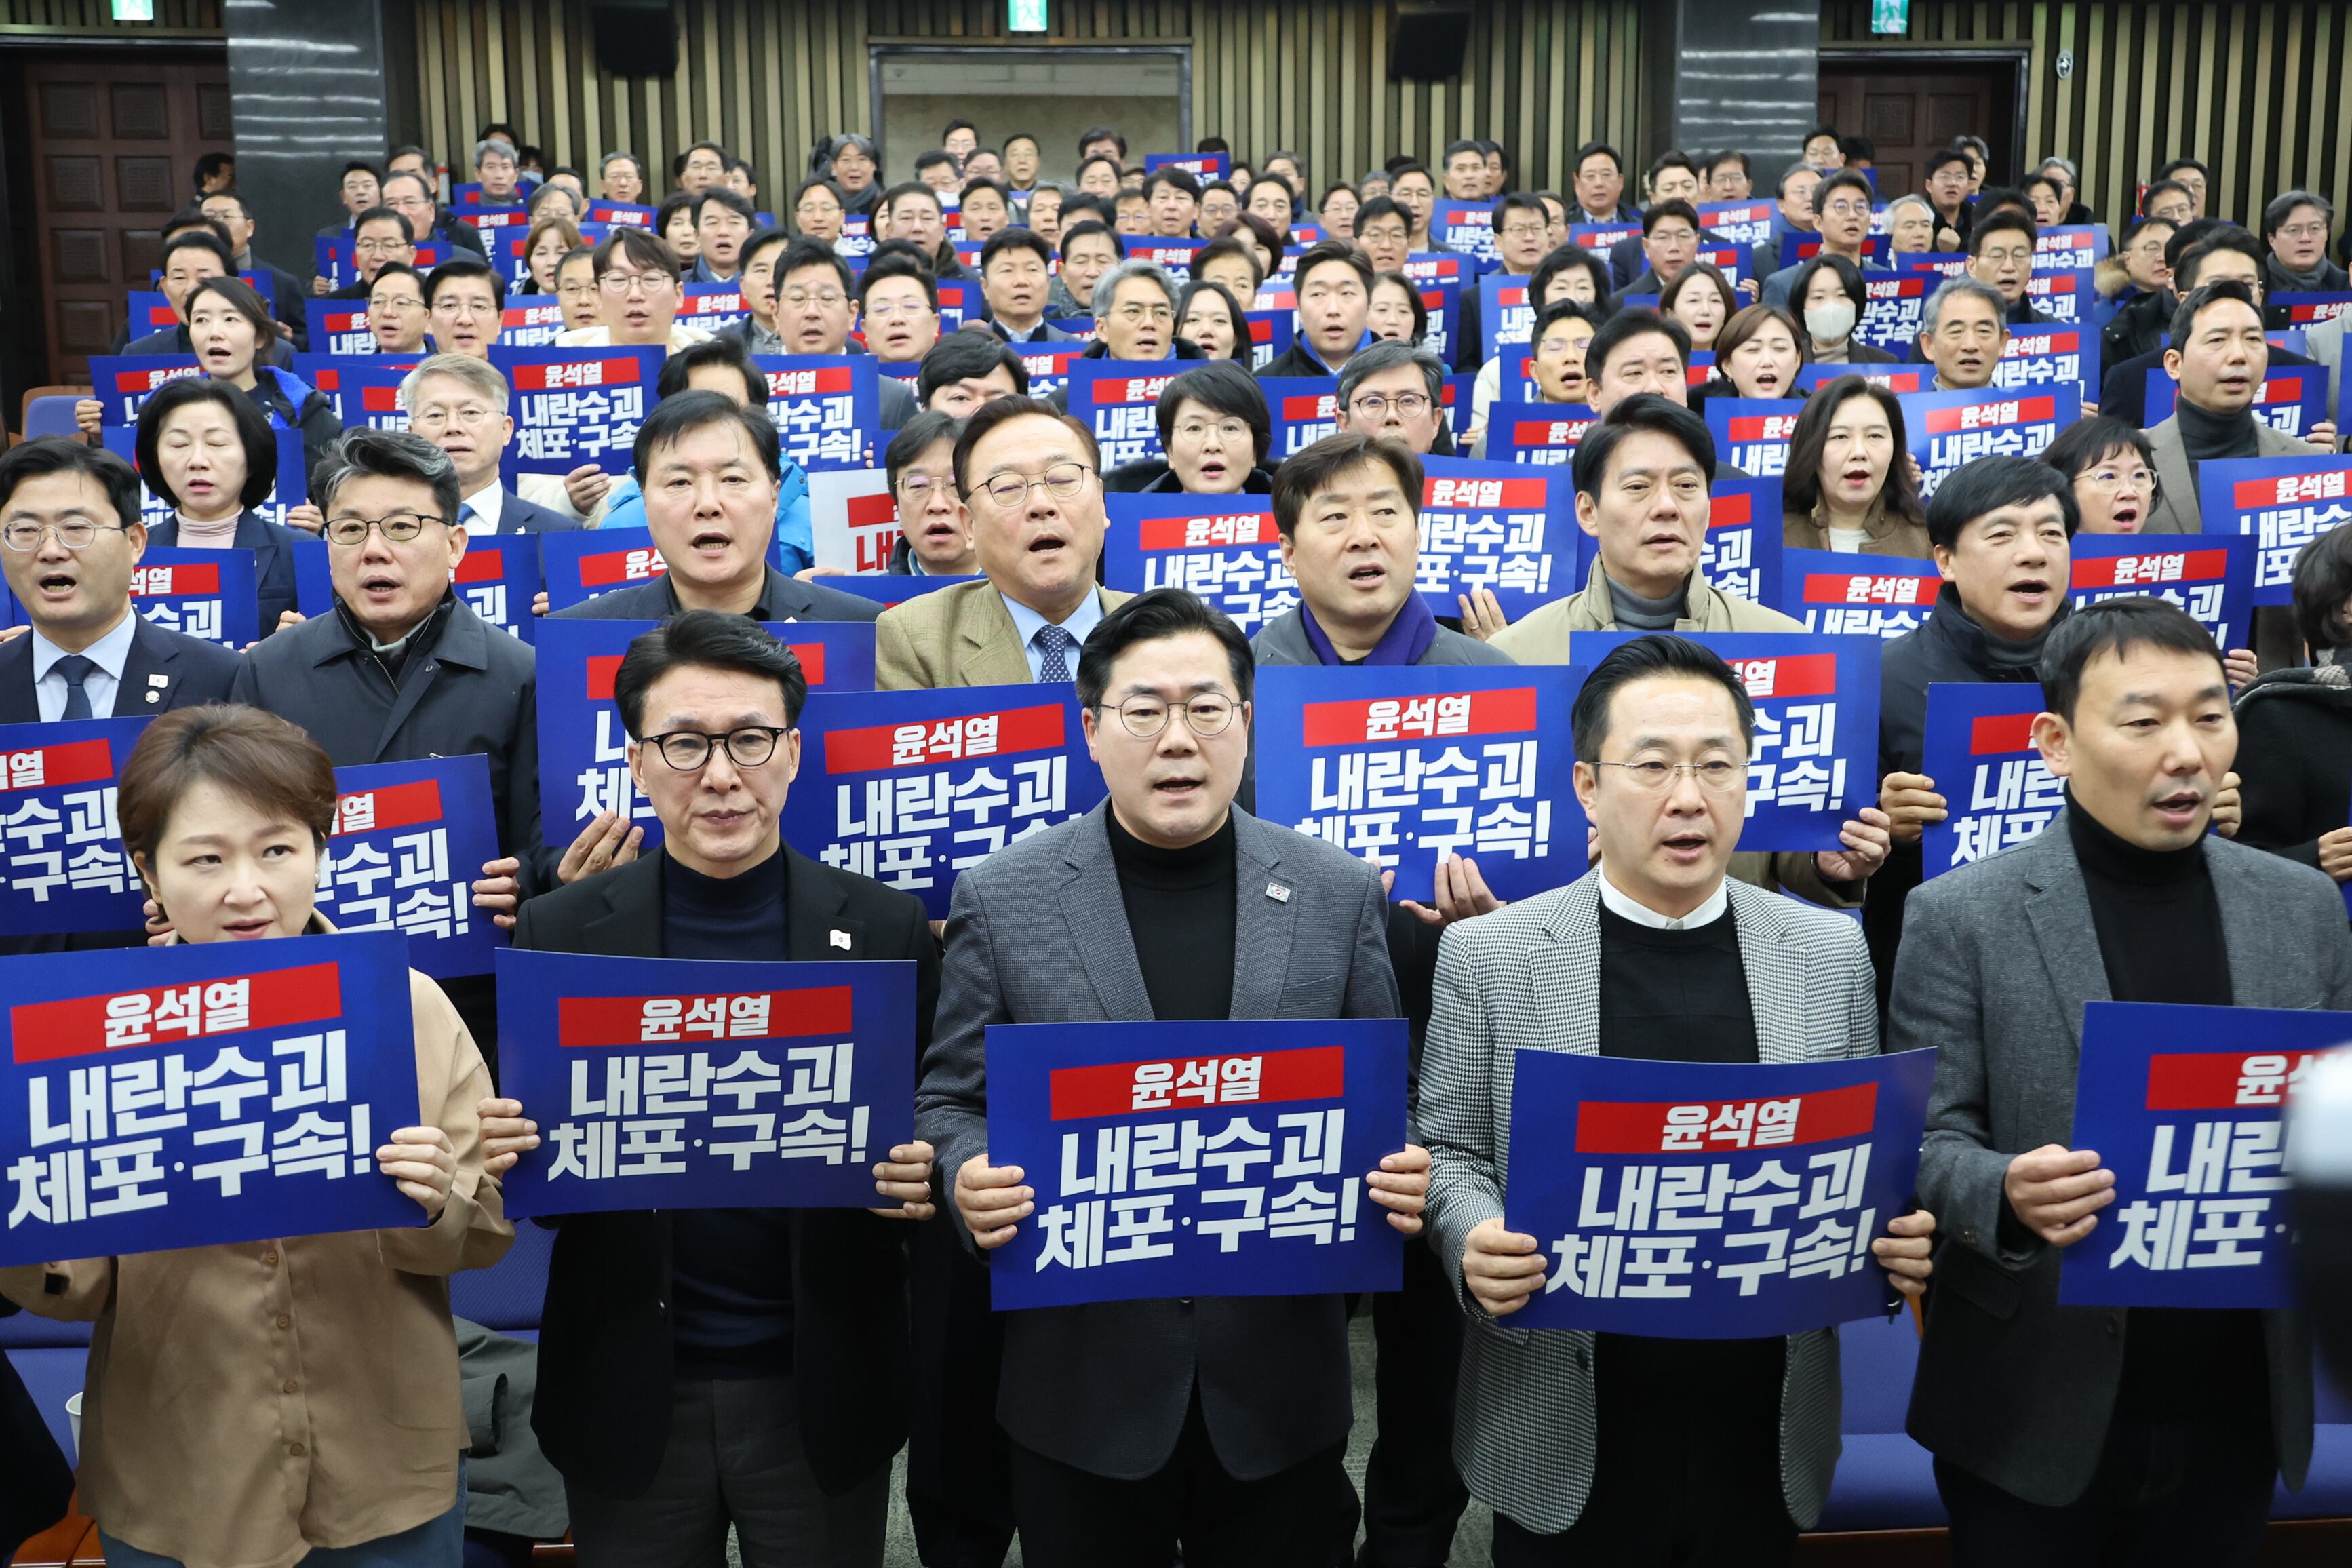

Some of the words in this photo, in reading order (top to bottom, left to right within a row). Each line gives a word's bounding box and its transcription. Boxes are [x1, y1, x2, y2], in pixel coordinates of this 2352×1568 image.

[1718, 208, 1751, 225] 윤석열
[1446, 226, 1495, 245] 내란수
[2036, 234, 2073, 252] 윤석열
[1153, 248, 1192, 264] 윤석열
[2031, 248, 2094, 269] 란수괴
[697, 293, 741, 314] 윤석열
[2024, 277, 2052, 296] 석열
[330, 332, 377, 355] 내란
[2004, 335, 2051, 357] 윤석열
[545, 361, 603, 388] 윤석열
[1023, 355, 1054, 376] 석열
[520, 386, 643, 427] 내란수괴
[1095, 405, 1158, 440] 내란
[1960, 401, 2020, 429] 윤석열
[516, 420, 644, 460] 체포·구속
[1731, 443, 1789, 476] 내란
[1431, 479, 1503, 507] 윤석열
[2275, 471, 2346, 505] 윤석열
[1184, 515, 1261, 547] 윤석열
[130, 567, 173, 595] 석열
[1413, 554, 1552, 594] 포·구속!
[2113, 553, 2186, 585] 윤석열
[1845, 576, 1920, 604] 윤석열
[1366, 694, 1472, 741] 윤석열
[892, 715, 998, 766] 윤석열
[1310, 740, 1538, 812] 내란수괴
[836, 755, 1067, 838] 내란수괴
[104, 978, 250, 1048] 윤석열
[640, 994, 771, 1041] 윤석열
[28, 1029, 347, 1148] 내란수괴
[570, 1042, 854, 1116] 내란수괴
[1132, 1055, 1263, 1110] 윤석열
[1660, 1098, 1801, 1151] 윤석열
[547, 1105, 869, 1182] 체포·구속!
[1060, 1108, 1345, 1197] 내란수괴
[2146, 1120, 2296, 1194] 내란
[7, 1103, 371, 1230] 체포·구속!
[1577, 1143, 1872, 1231] 내란수괴
[1036, 1177, 1360, 1273] 체포·구속!
[1545, 1208, 1875, 1299] 체포·구속!
